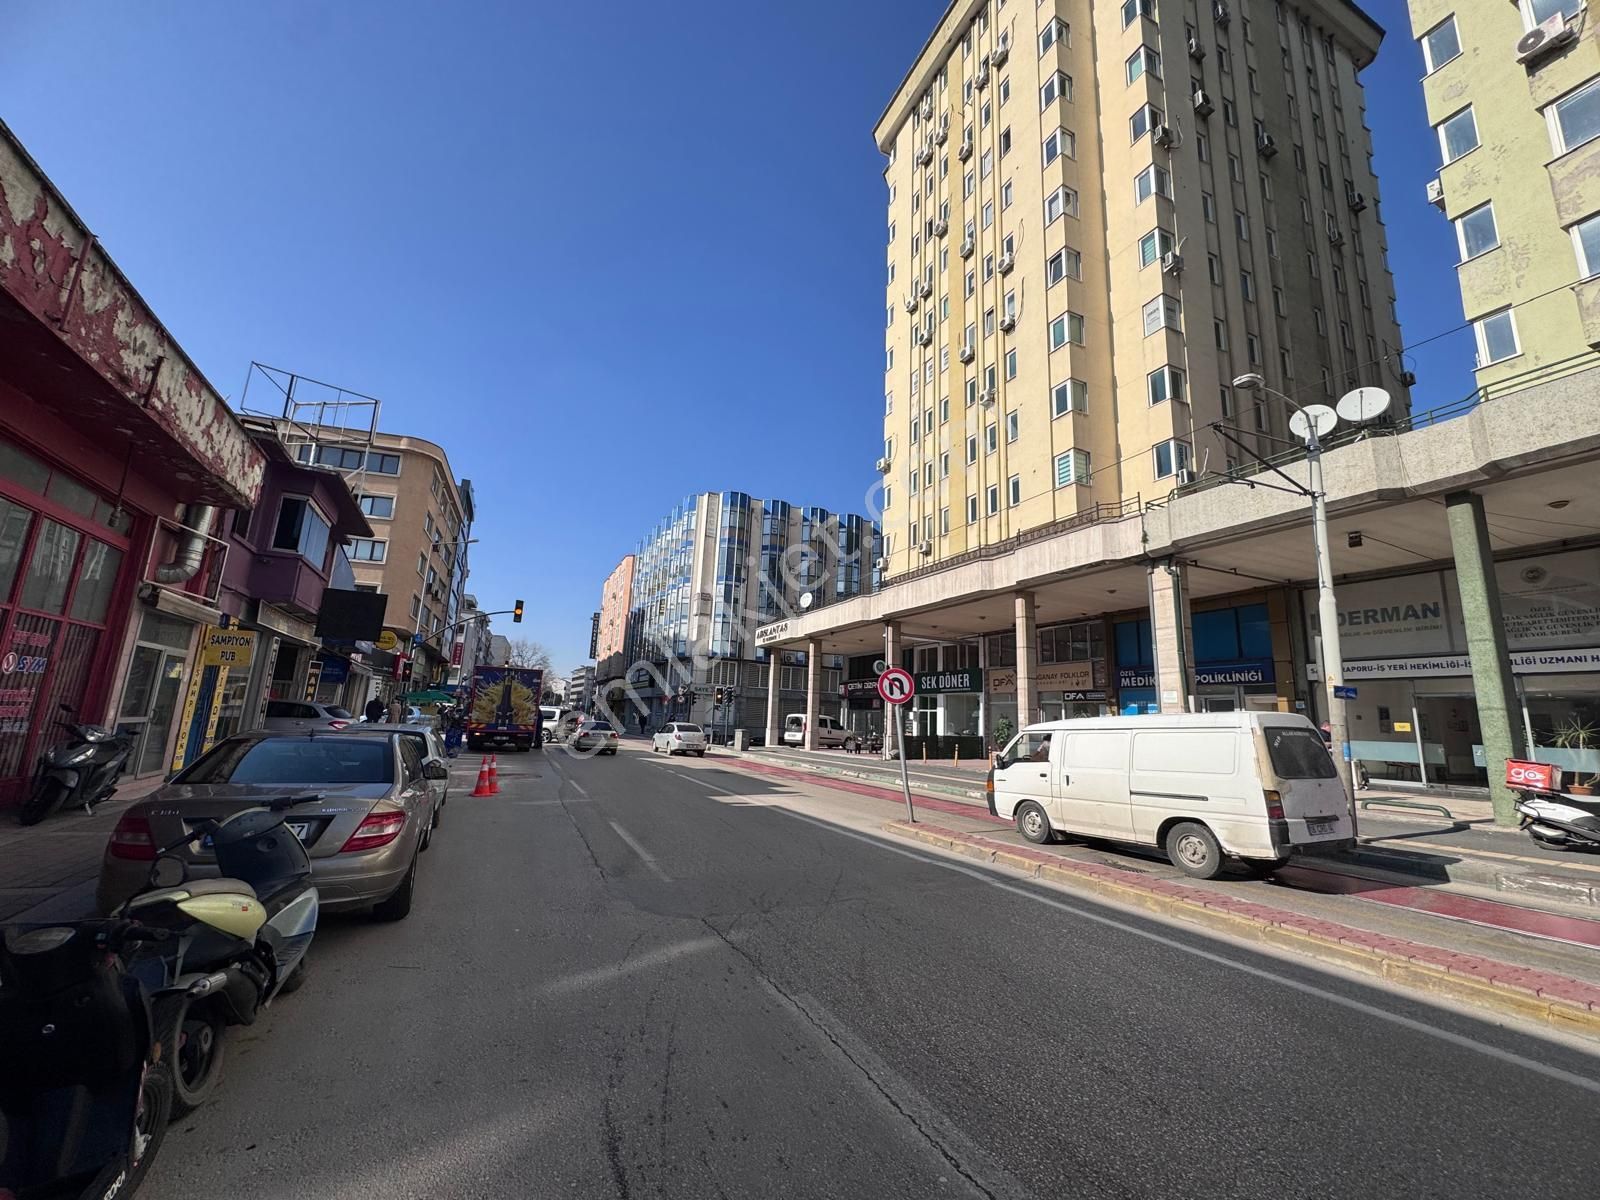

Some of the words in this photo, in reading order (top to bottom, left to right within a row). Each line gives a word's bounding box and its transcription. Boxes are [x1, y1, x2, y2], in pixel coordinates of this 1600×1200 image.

[220, 650, 236, 661] PUB
[1539, 654, 1588, 665] UZMANI
[16, 656, 48, 674] SYM
[921, 675, 937, 690] SEK
[937, 672, 970, 689] DÖNER
[1120, 673, 1157, 687] MEDİK
[1064, 691, 1085, 700] DFA
